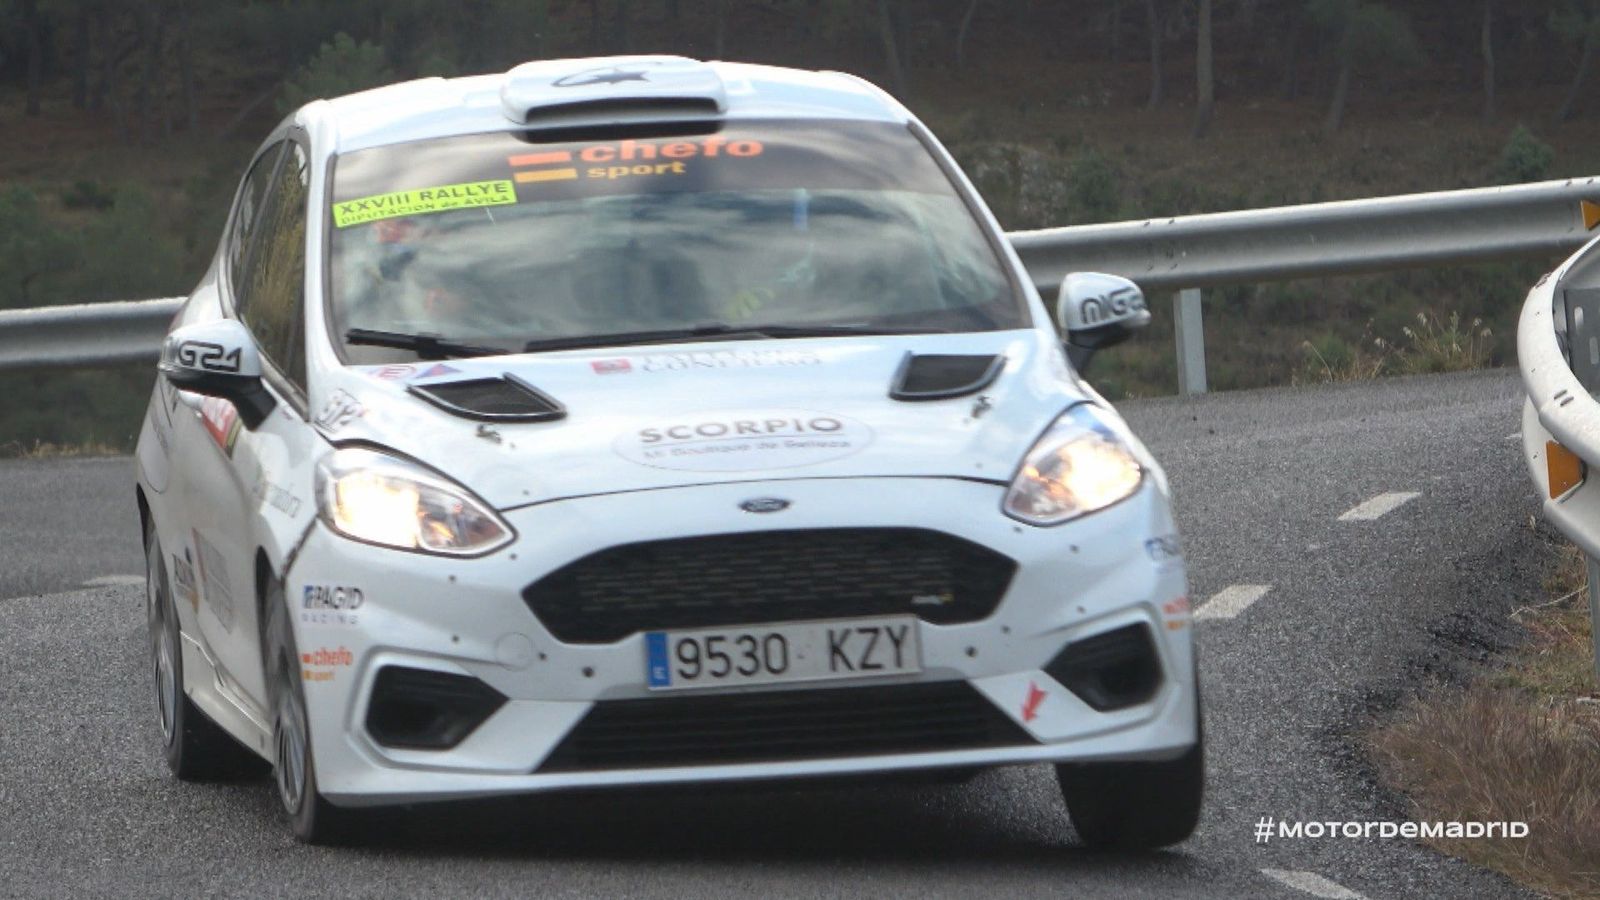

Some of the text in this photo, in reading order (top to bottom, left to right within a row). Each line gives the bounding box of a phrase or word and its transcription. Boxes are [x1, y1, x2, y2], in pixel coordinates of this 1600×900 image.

[580, 135, 764, 162] chefo
[587, 161, 686, 179] sport
[341, 183, 509, 215] XXVIII RALLYE
[638, 417, 843, 443] SCORPIO
[676, 633, 788, 681] 9530
[828, 625, 909, 673] KZY
